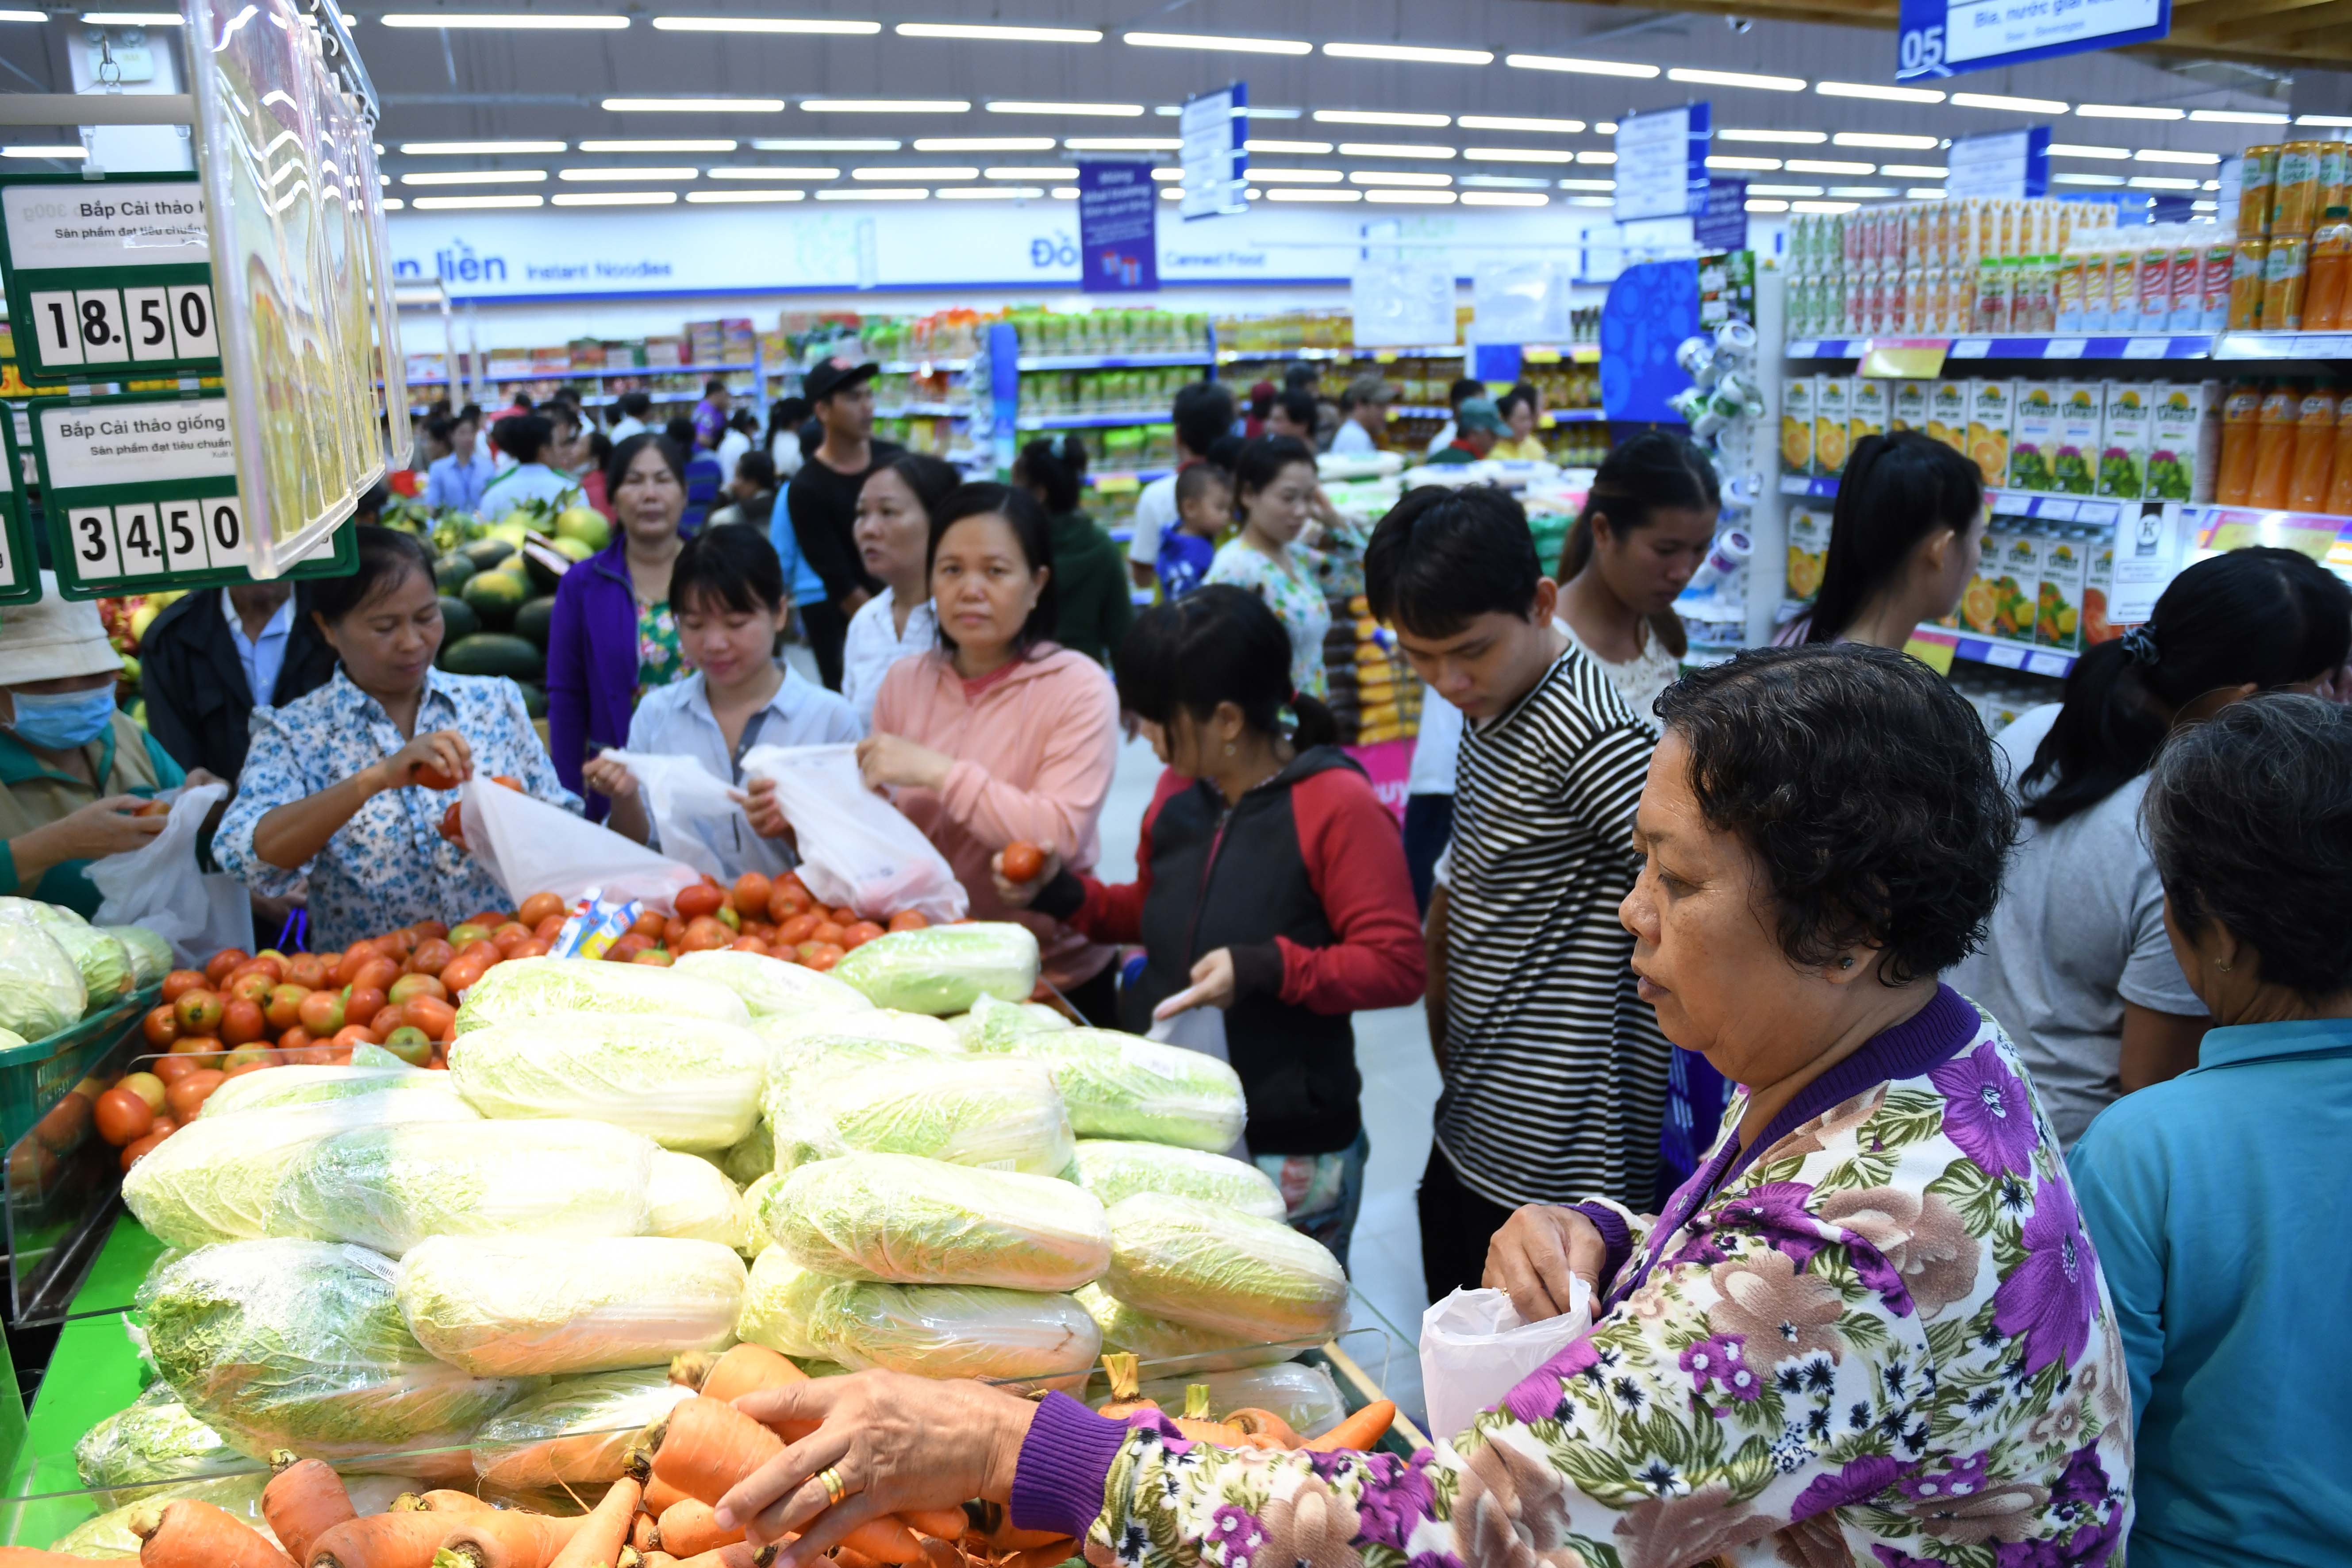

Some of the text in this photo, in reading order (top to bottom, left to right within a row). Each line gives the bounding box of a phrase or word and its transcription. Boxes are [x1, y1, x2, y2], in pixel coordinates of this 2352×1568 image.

[1902, 25, 1943, 69] 05
[80, 200, 115, 219] Bắp
[121, 199, 150, 216] Cải
[155, 200, 194, 215] thảo
[55, 227, 78, 238] Sản
[82, 226, 115, 240] phẩm
[119, 226, 136, 237] đạt
[436, 237, 507, 281] liền
[1031, 229, 1078, 268] Đồ
[526, 262, 589, 280] Instant
[60, 414, 225, 439] Bắp Cải thảo giống
[91, 437, 231, 456] Sản phẩm đạt tiêu chuẩn
